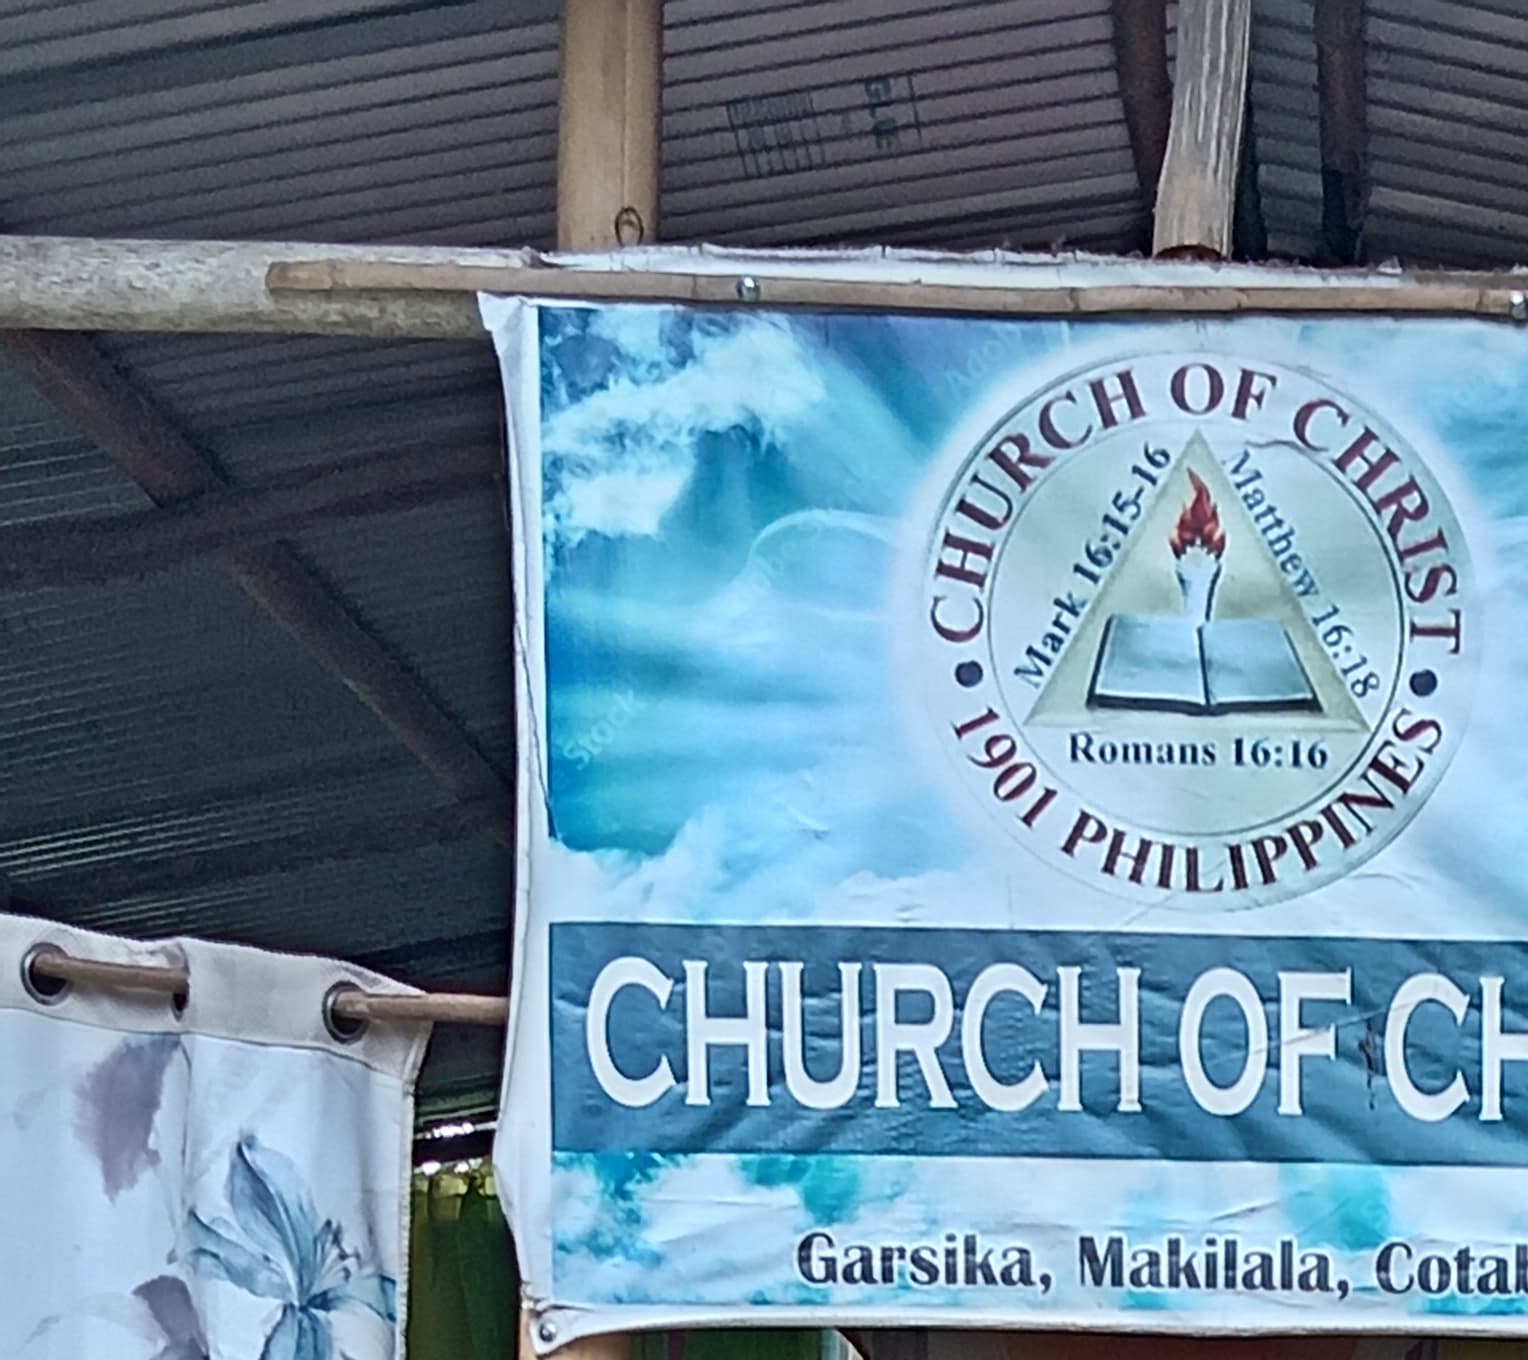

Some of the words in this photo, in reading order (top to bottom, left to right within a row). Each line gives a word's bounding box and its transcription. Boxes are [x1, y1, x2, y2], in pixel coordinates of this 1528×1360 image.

[931, 369, 1147, 645] CHURCH
[1170, 362, 1278, 421] OF
[1292, 398, 1463, 655] CHRIST
[1013, 591, 1088, 690] Mark
[1073, 440, 1171, 585] 16:15-16
[1222, 449, 1319, 599] Matthew
[1312, 603, 1381, 699] 16:18
[952, 707, 1060, 829] 1901
[1060, 708, 1444, 895] PHILIPPINES
[1069, 731, 1217, 767] Romans
[1232, 736, 1329, 770] 16:16
[585, 956, 1143, 1113] CHURCH
[1177, 966, 1352, 1118] OF
[798, 1230, 1054, 1295] Garsika,
[1078, 1234, 1352, 1301] Makilala,
